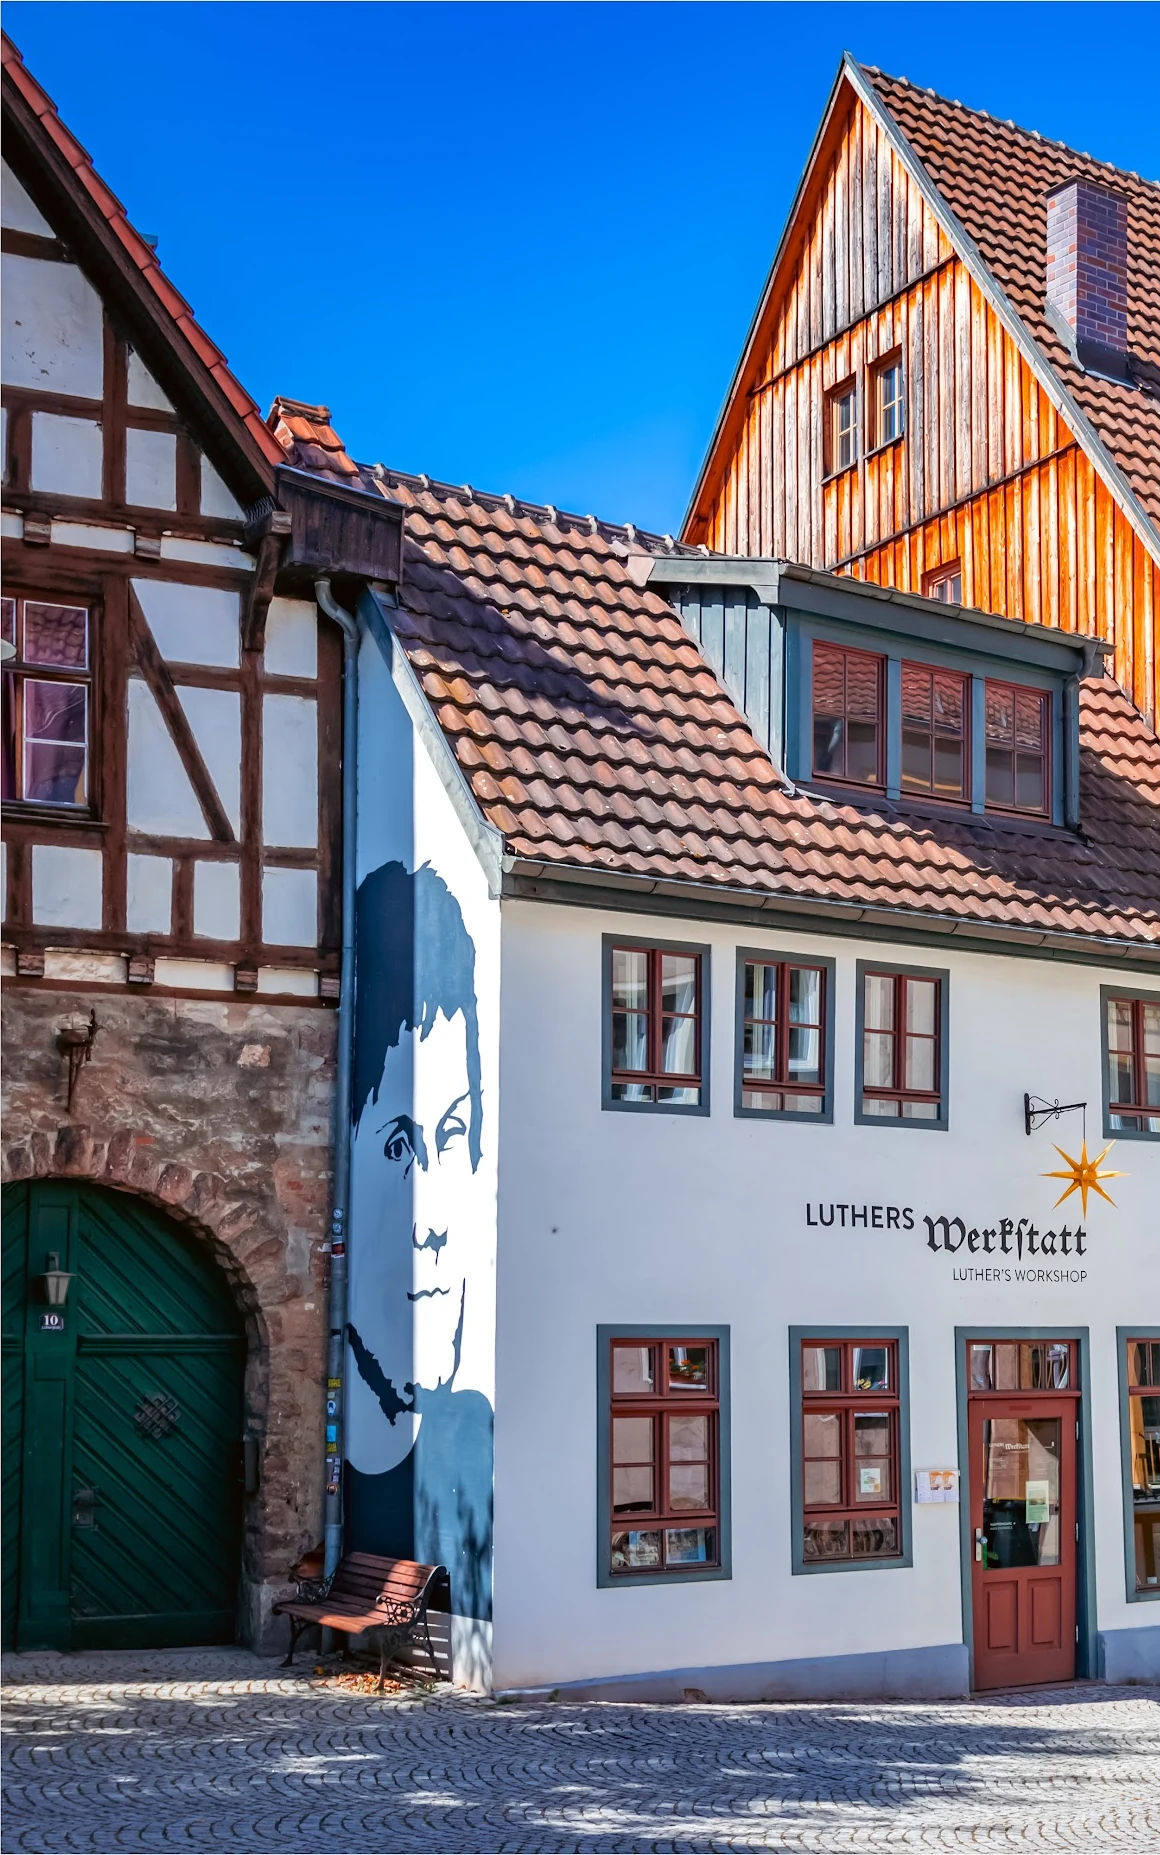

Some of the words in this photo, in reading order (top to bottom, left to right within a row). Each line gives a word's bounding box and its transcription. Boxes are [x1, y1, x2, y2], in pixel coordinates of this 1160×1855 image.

[806, 1202, 915, 1230] LUTHERS
[1014, 1268, 1088, 1283] WORKSHOP
[44, 1314, 59, 1326] 10
